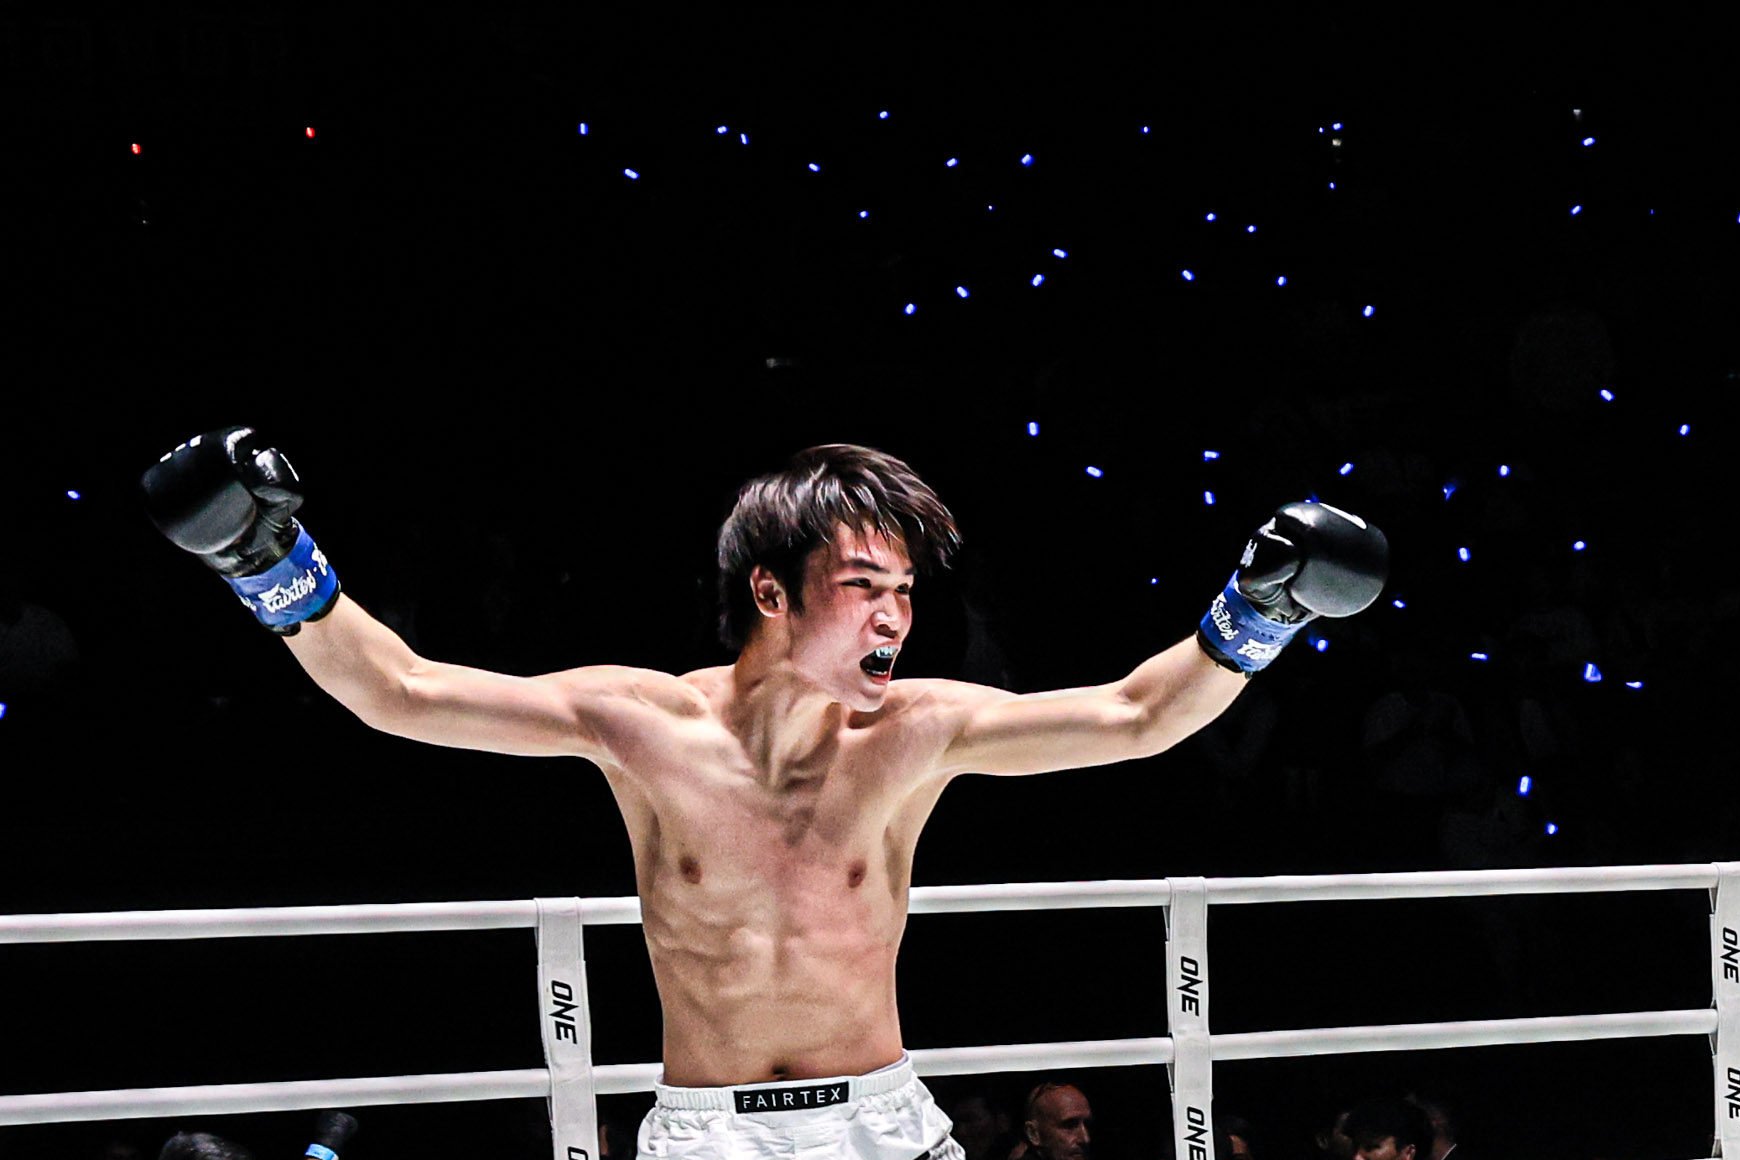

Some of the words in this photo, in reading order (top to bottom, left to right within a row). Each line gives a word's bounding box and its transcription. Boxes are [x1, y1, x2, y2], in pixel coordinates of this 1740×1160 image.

[548, 979, 580, 1045] ONE
[1176, 955, 1204, 1017] ONE
[742, 1086, 842, 1110] FAIRTEX
